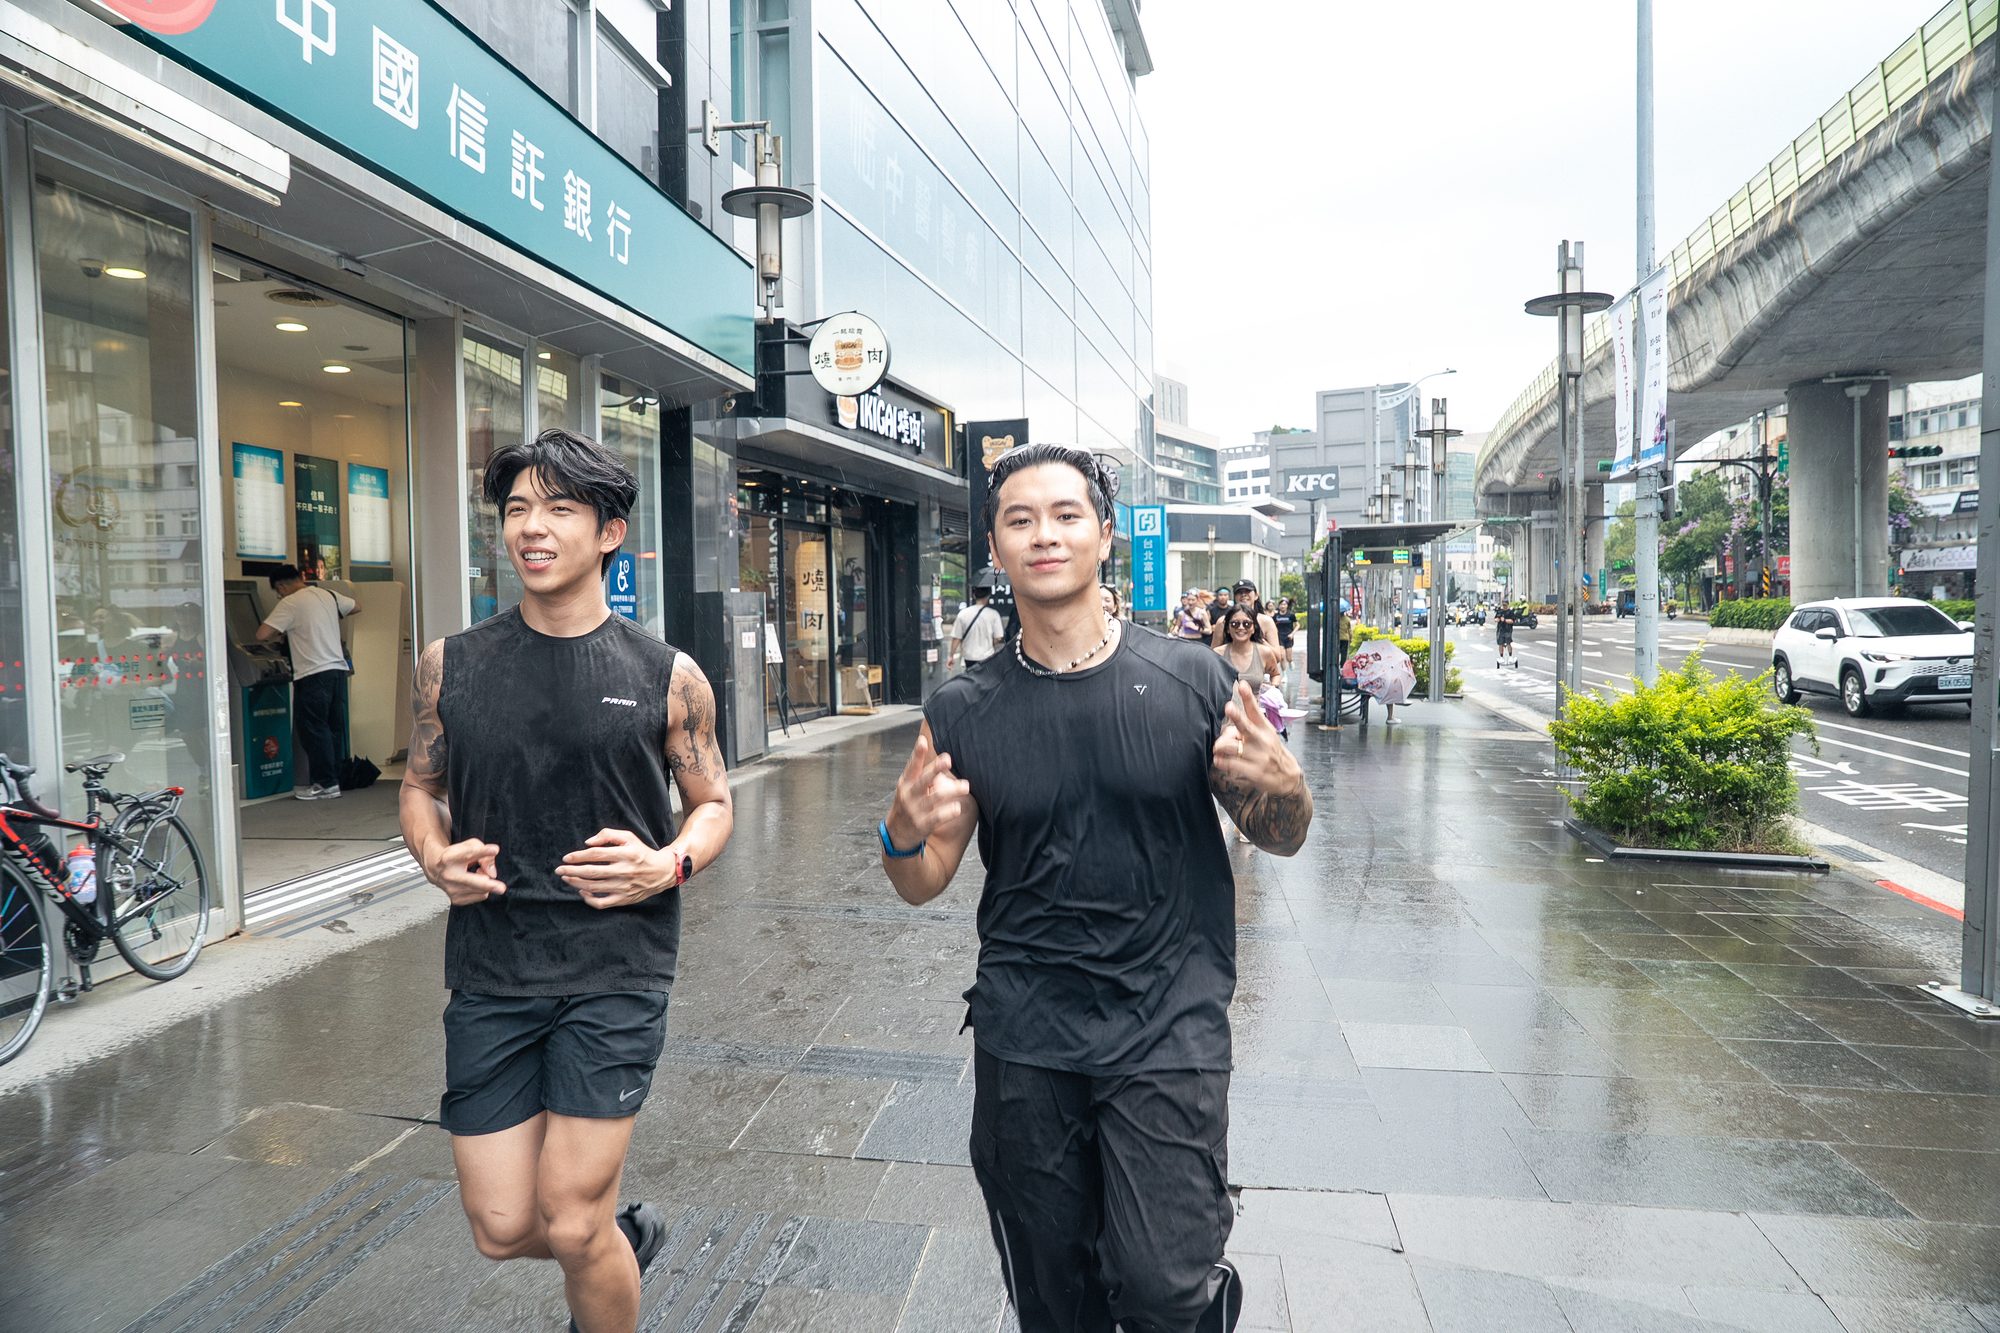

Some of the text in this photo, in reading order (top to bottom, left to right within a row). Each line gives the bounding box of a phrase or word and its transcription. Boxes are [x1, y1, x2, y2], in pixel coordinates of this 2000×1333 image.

[276, 0, 632, 266] 中國信託銀行
[867, 348, 883, 364] 肉
[1286, 473, 1336, 493] KFC
[802, 568, 826, 631] 燒肉
